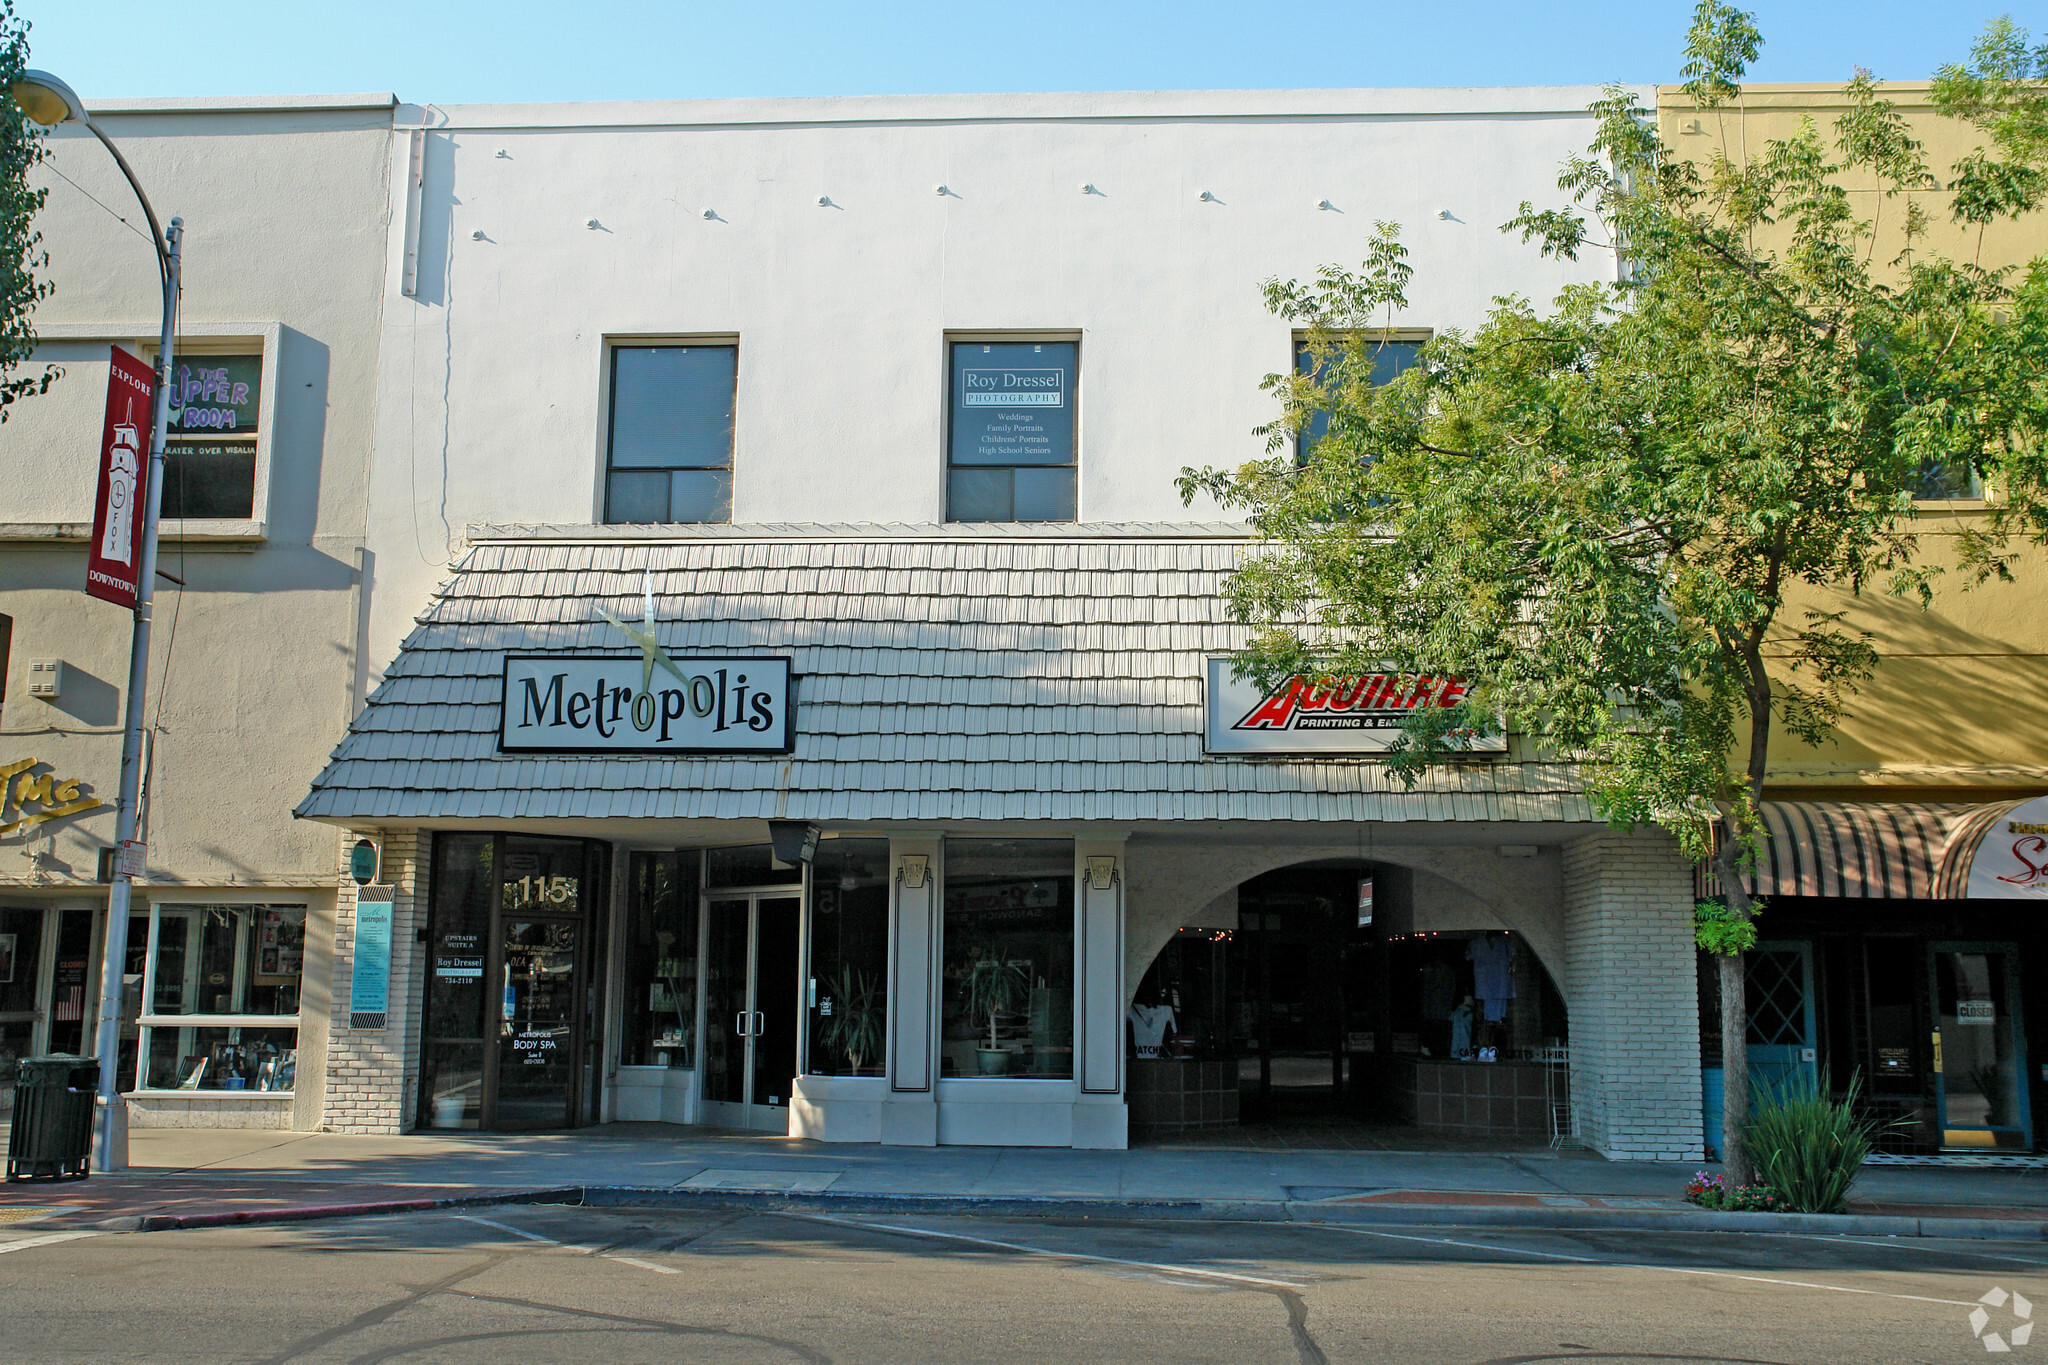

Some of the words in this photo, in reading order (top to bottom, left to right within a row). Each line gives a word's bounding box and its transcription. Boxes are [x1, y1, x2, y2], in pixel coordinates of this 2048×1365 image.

[111, 364, 151, 397] EXPLORE
[197, 368, 229, 382] THE
[169, 364, 250, 407] UPPER
[966, 373, 998, 390] Roy
[1003, 373, 1060, 387] Dressel
[968, 394, 1059, 402] PHOTOGRAPHY
[184, 406, 237, 430] ROOM
[998, 413, 1034, 422] Weddings
[987, 424, 1012, 433] Family
[1013, 424, 1044, 432] Portraits
[981, 435, 1018, 443] Childrens'
[1019, 435, 1049, 443] Portraits
[165, 446, 194, 455] RAYER
[199, 446, 222, 455] OVER
[225, 446, 256, 455] VISALIA
[978, 446, 997, 455] High
[998, 446, 1023, 454] School
[1024, 446, 1052, 454] Seniors
[110, 512, 119, 552] FOX
[89, 569, 137, 595] DOWNTOWN
[517, 667, 774, 743] Metropolis
[1299, 718, 1361, 728] PRINTING
[1364, 718, 1374, 728] &
[518, 875, 569, 903] 115
[59, 961, 87, 969] CLOSED
[437, 957, 453, 967] Roy
[454, 957, 483, 967] Dressel
[1960, 1006, 1993, 1018] CLOSED
[513, 1039, 538, 1050] BODY
[540, 1040, 557, 1050] SPA
